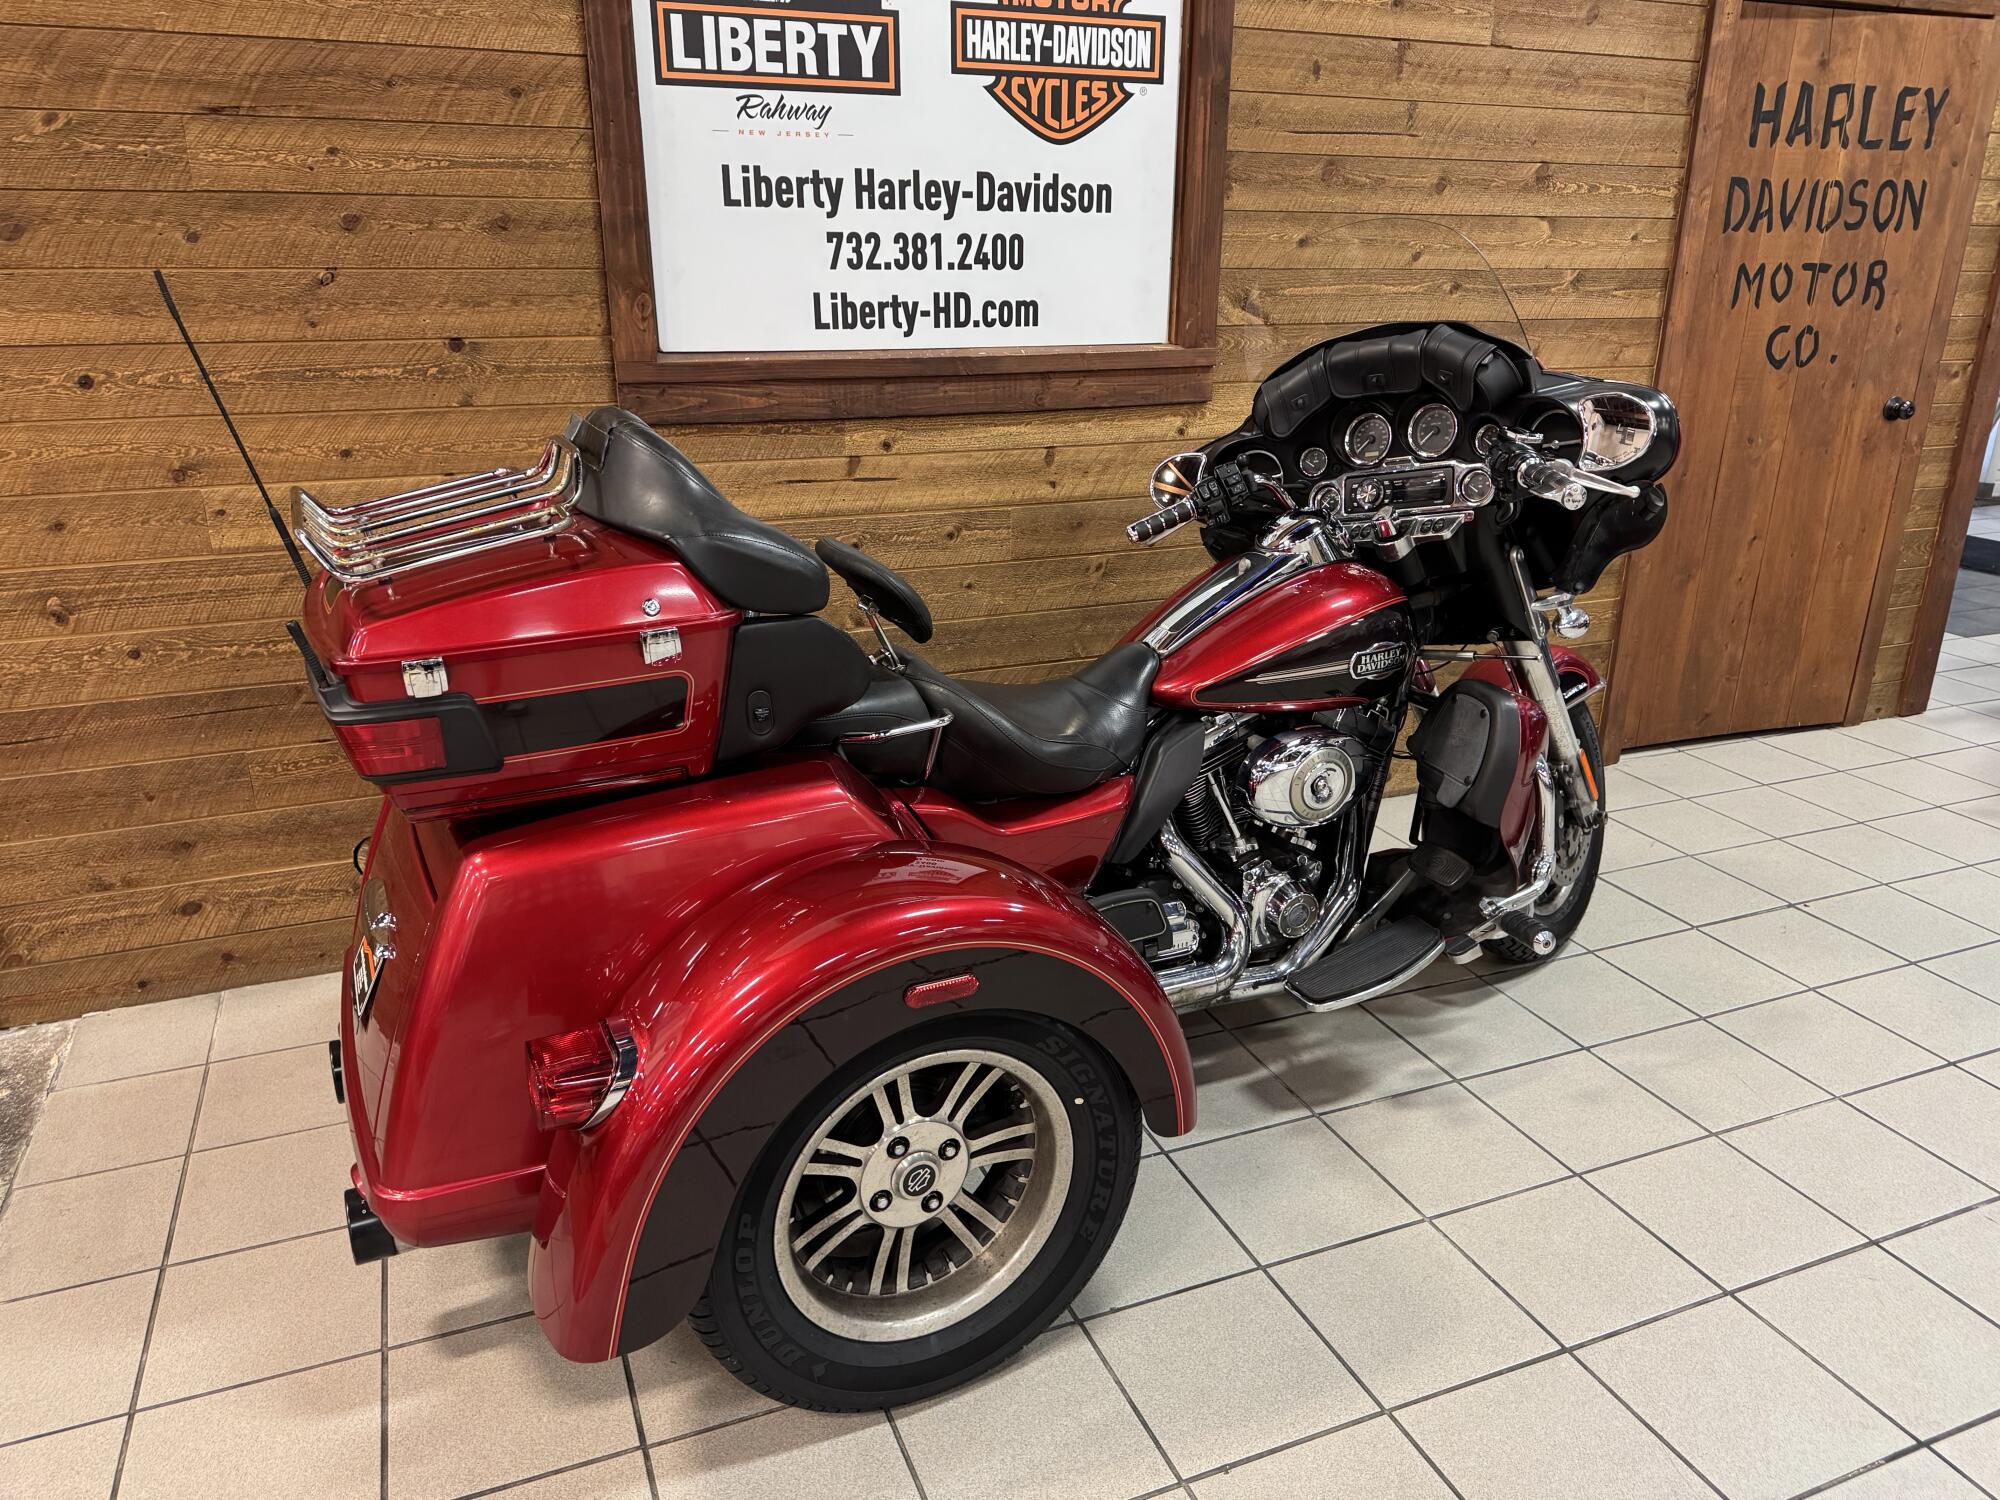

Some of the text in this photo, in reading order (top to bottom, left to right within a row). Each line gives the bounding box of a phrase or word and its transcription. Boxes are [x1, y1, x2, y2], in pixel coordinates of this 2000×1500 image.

[669, 13, 883, 78] LIBERTY
[966, 18, 1152, 69] HARLEY-DAVIDSON
[735, 93, 833, 130] Rahway
[1011, 76, 1108, 130] CYCLES
[1748, 81, 1950, 150] HARLEY
[776, 130, 830, 138] JERSEY
[720, 164, 1113, 221] Liberty Harley-Davidson
[1722, 176, 1928, 234] DAVIDSON
[826, 231, 1025, 272] 732.381.2400
[1731, 259, 1889, 311] MOTOR
[813, 291, 1040, 338] Liberty-HD.com
[1765, 324, 1838, 370] CO.
[1361, 647, 1402, 665] HARLEY
[1036, 1035, 1118, 1243] SIGNATURE
[735, 1213, 808, 1367] DUNLOP
